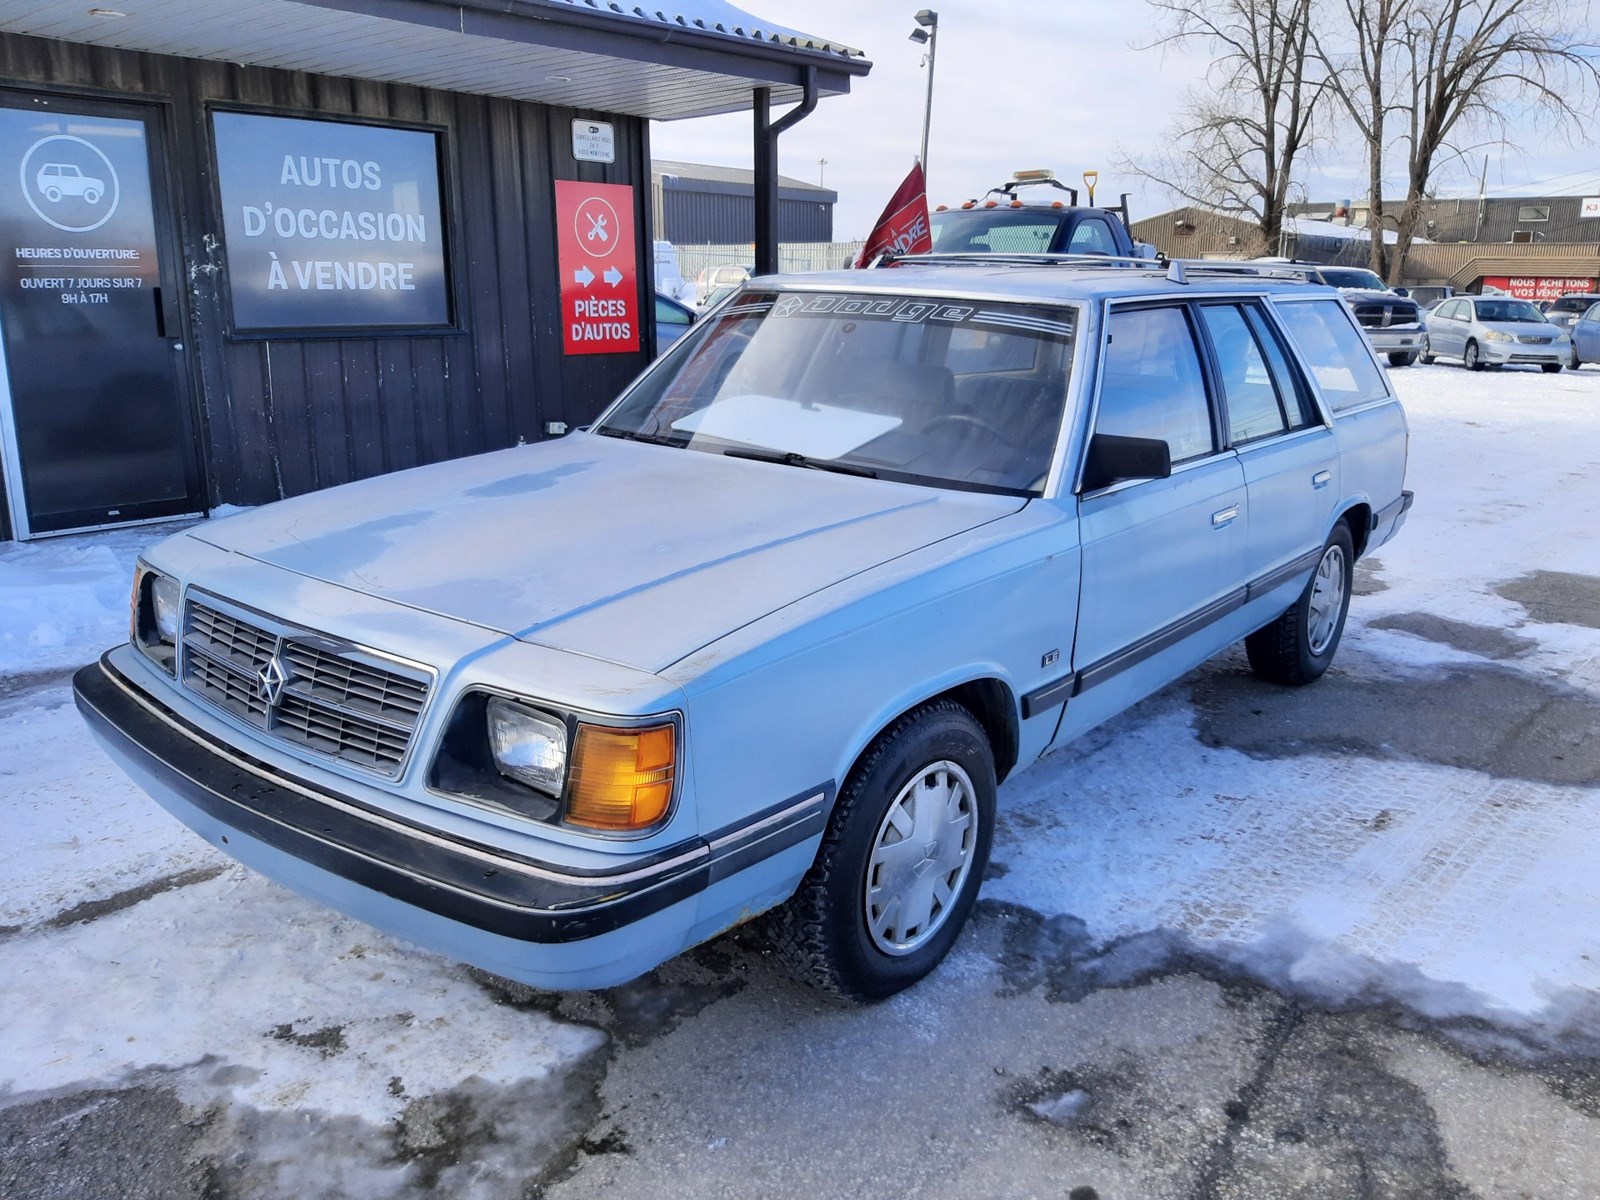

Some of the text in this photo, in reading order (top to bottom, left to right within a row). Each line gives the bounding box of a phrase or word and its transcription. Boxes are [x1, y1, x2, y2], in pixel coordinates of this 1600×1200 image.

[281, 155, 382, 191] AUTOS
[16, 248, 61, 259] HEURES
[267, 251, 416, 291] À VENDRE
[20, 277, 142, 289] OUVERT 7 JOURS SUR 7
[1509, 278, 1535, 287] NOUS
[61, 290, 108, 304] 9H À 17H
[1514, 288, 1534, 297] VOS
[575, 296, 626, 318] PIÈCES
[800, 296, 974, 323] Dodge
[572, 323, 631, 342] D'AUTOS
